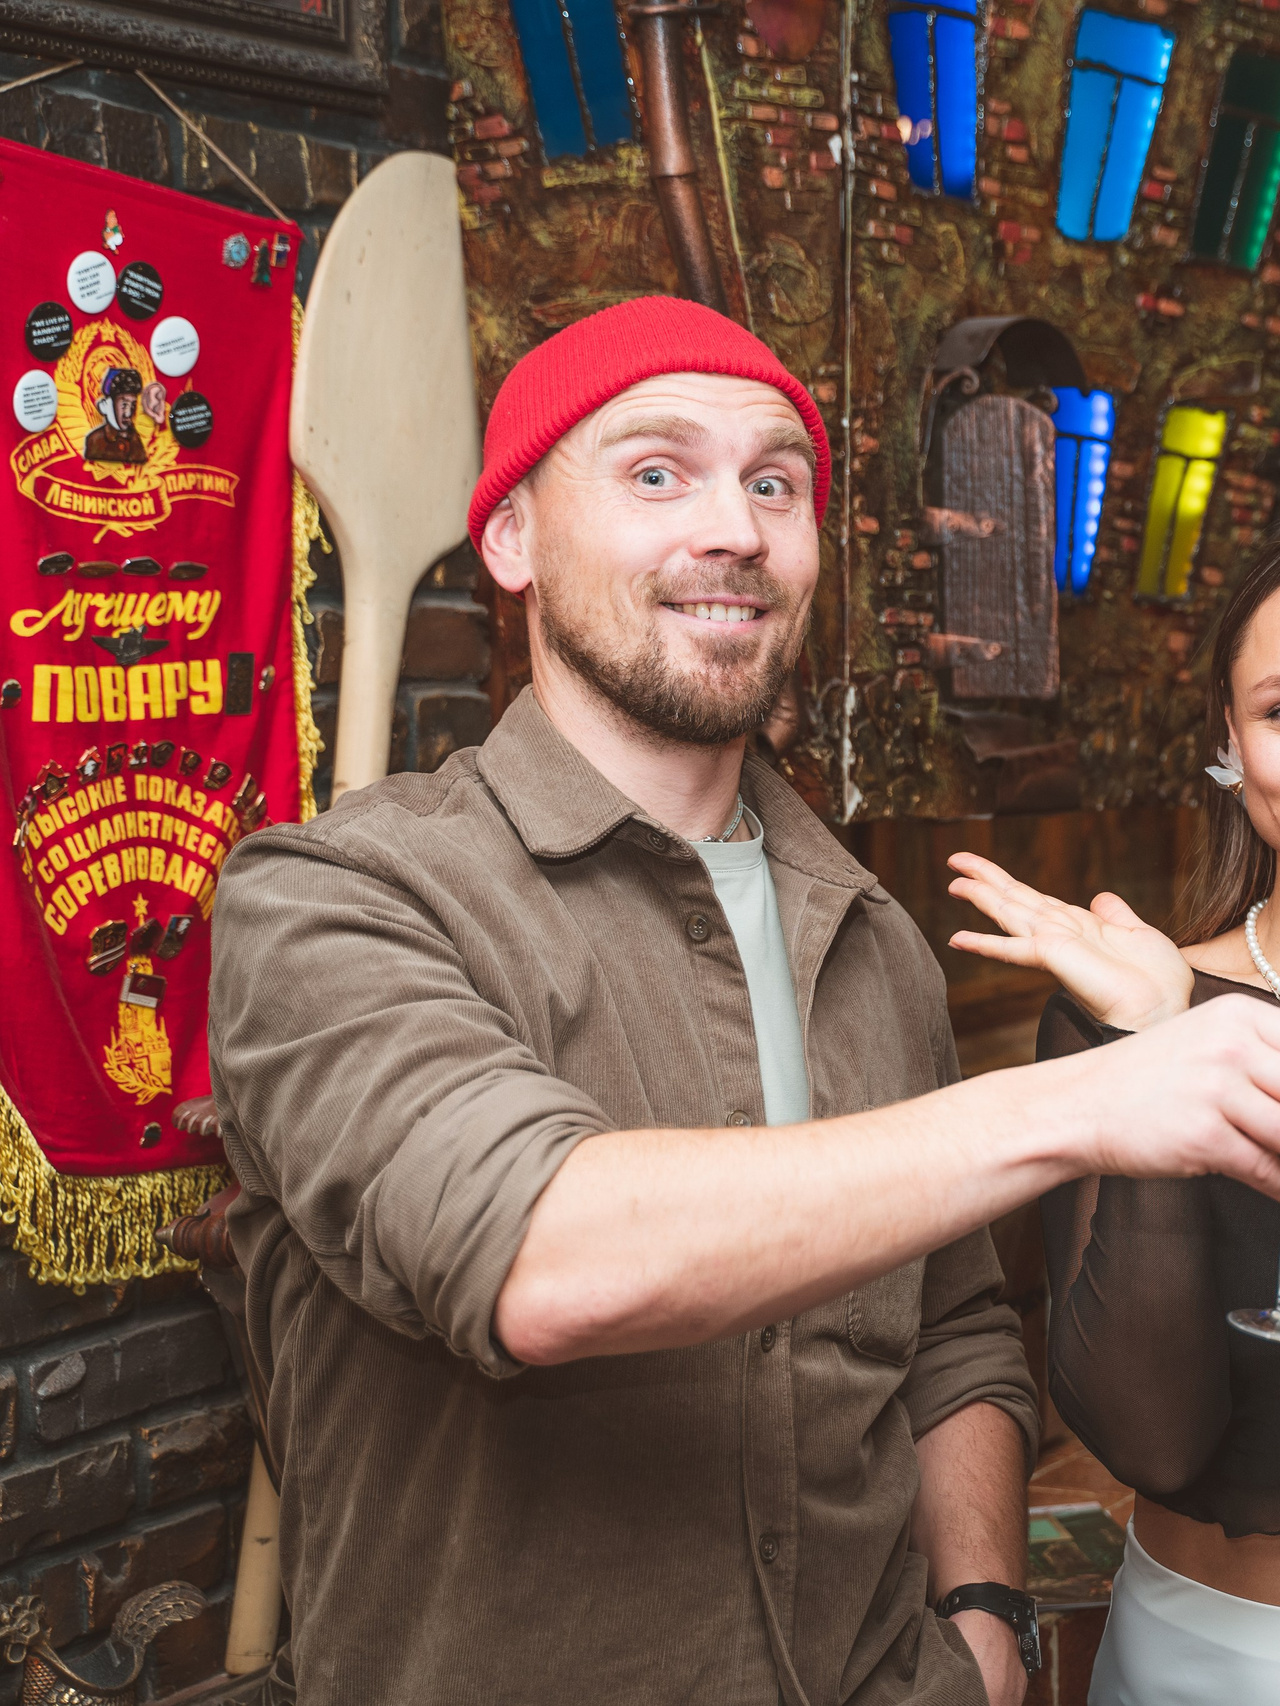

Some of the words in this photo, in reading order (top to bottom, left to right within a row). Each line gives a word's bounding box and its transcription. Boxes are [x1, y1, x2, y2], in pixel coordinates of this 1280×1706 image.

[17, 433, 65, 474] СЛАВА
[45, 483, 156, 518] ЛЕНИНСКОЙ
[166, 472, 231, 495] ПАРТИИ!
[31, 658, 224, 724] ПОВАРУ
[28, 775, 128, 850] ВЫСОКИЕ
[134, 773, 241, 847] ПОКАЗАТЕ
[37, 811, 228, 884] СОЦИАЛИСТИЧЕСК
